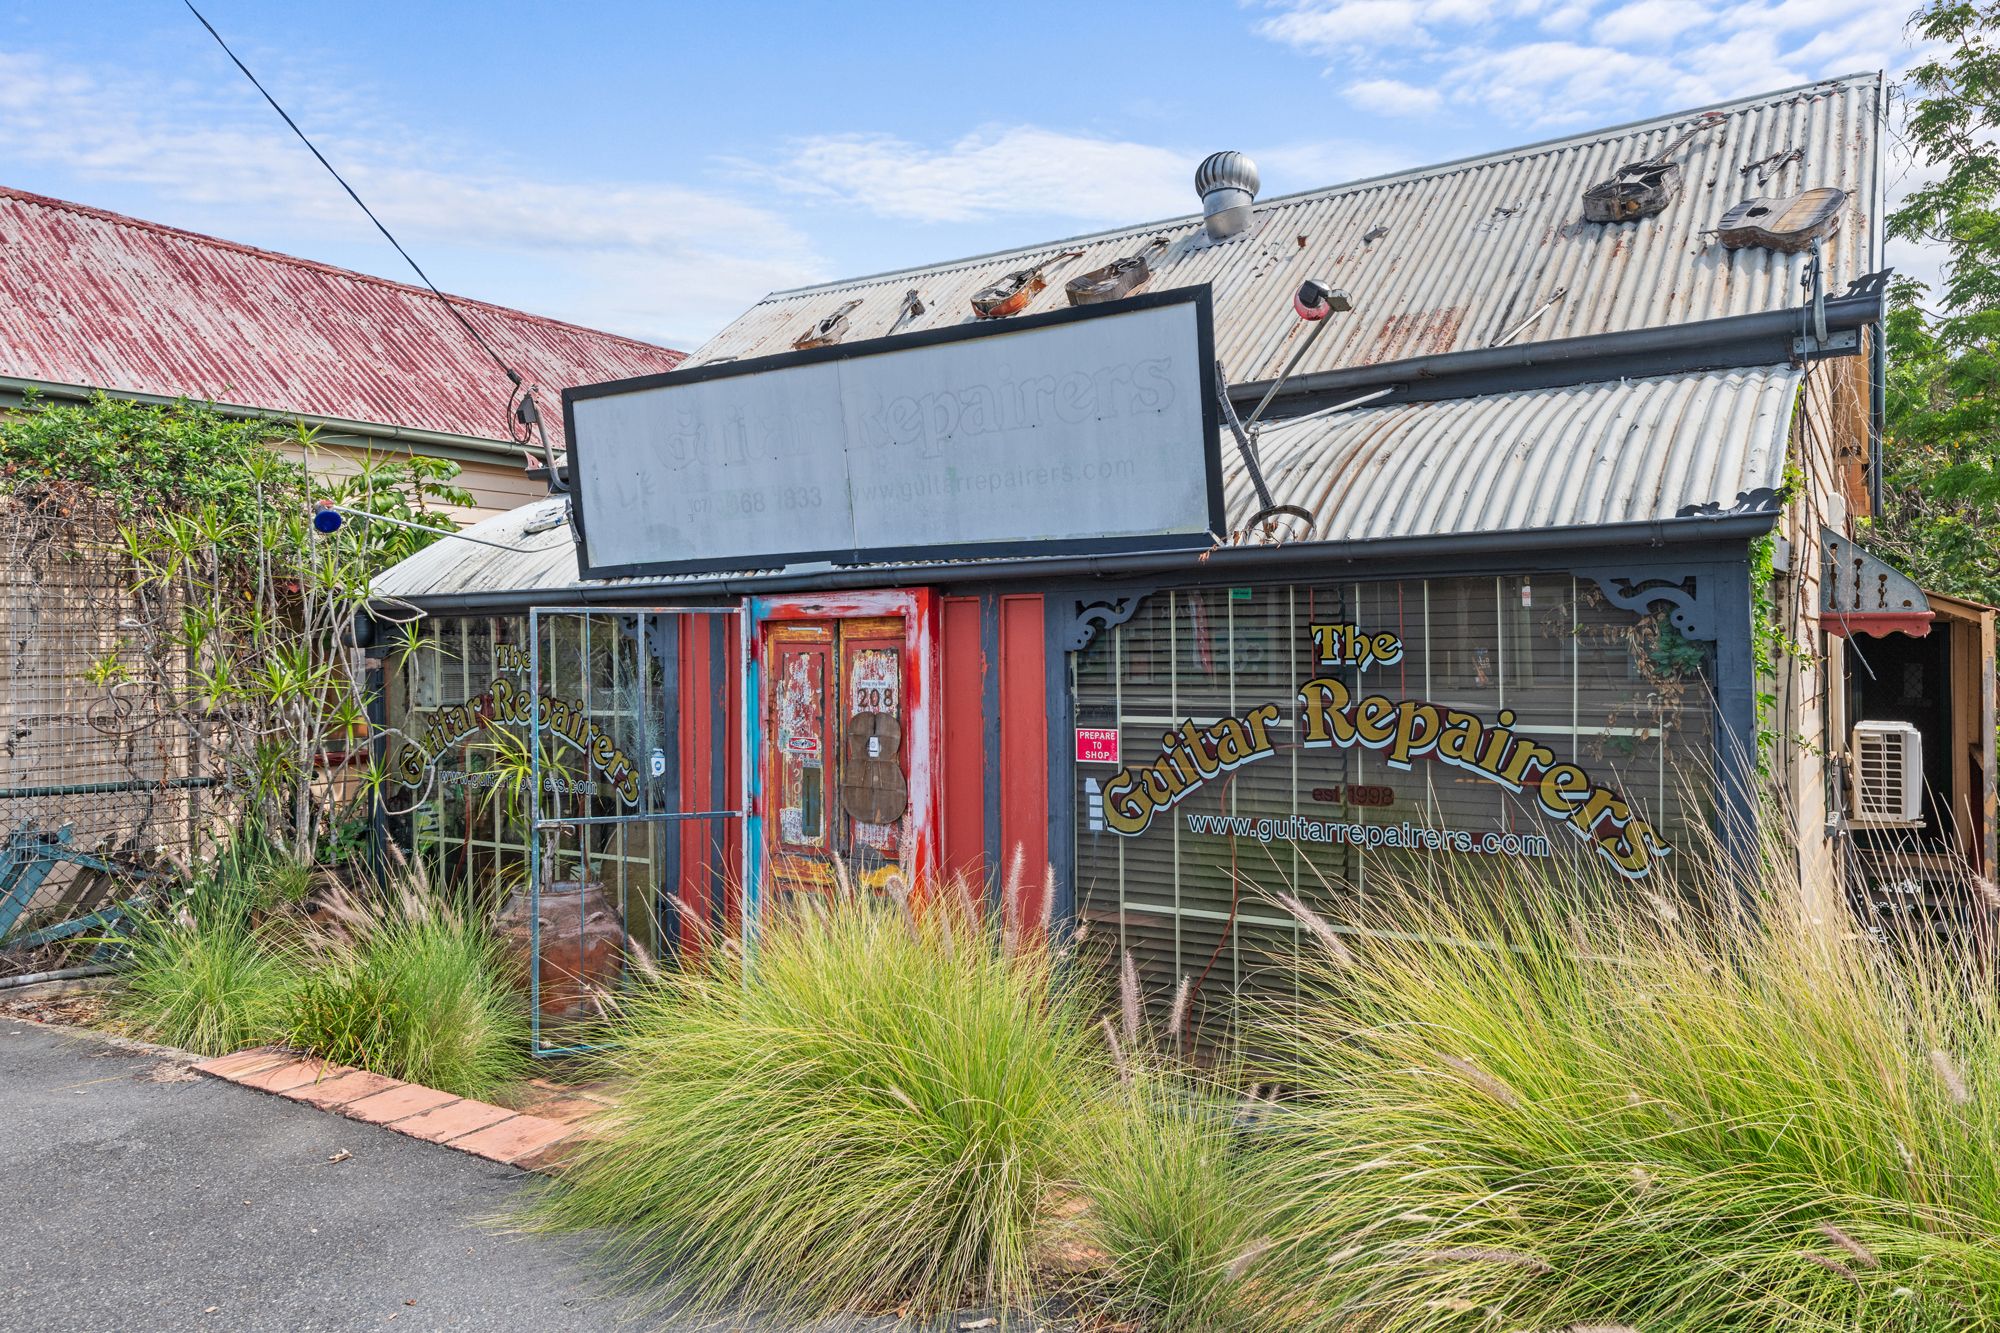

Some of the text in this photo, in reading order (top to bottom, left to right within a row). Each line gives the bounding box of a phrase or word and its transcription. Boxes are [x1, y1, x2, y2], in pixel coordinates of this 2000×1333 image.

[651, 355, 1177, 470] Guitar Repairers
[494, 643, 532, 676] The
[1309, 622, 1404, 673] The
[857, 688, 893, 707] 208
[399, 678, 640, 807] Guitar Repairers
[1079, 731, 1116, 740] PREPARE
[1092, 741, 1103, 750] TO
[1085, 750, 1111, 760] SHOP
[1103, 677, 1672, 879] Guitar Repairers
[1347, 784, 1394, 806] 1998
[1187, 813, 1550, 857] www.guitarrepairers.com
